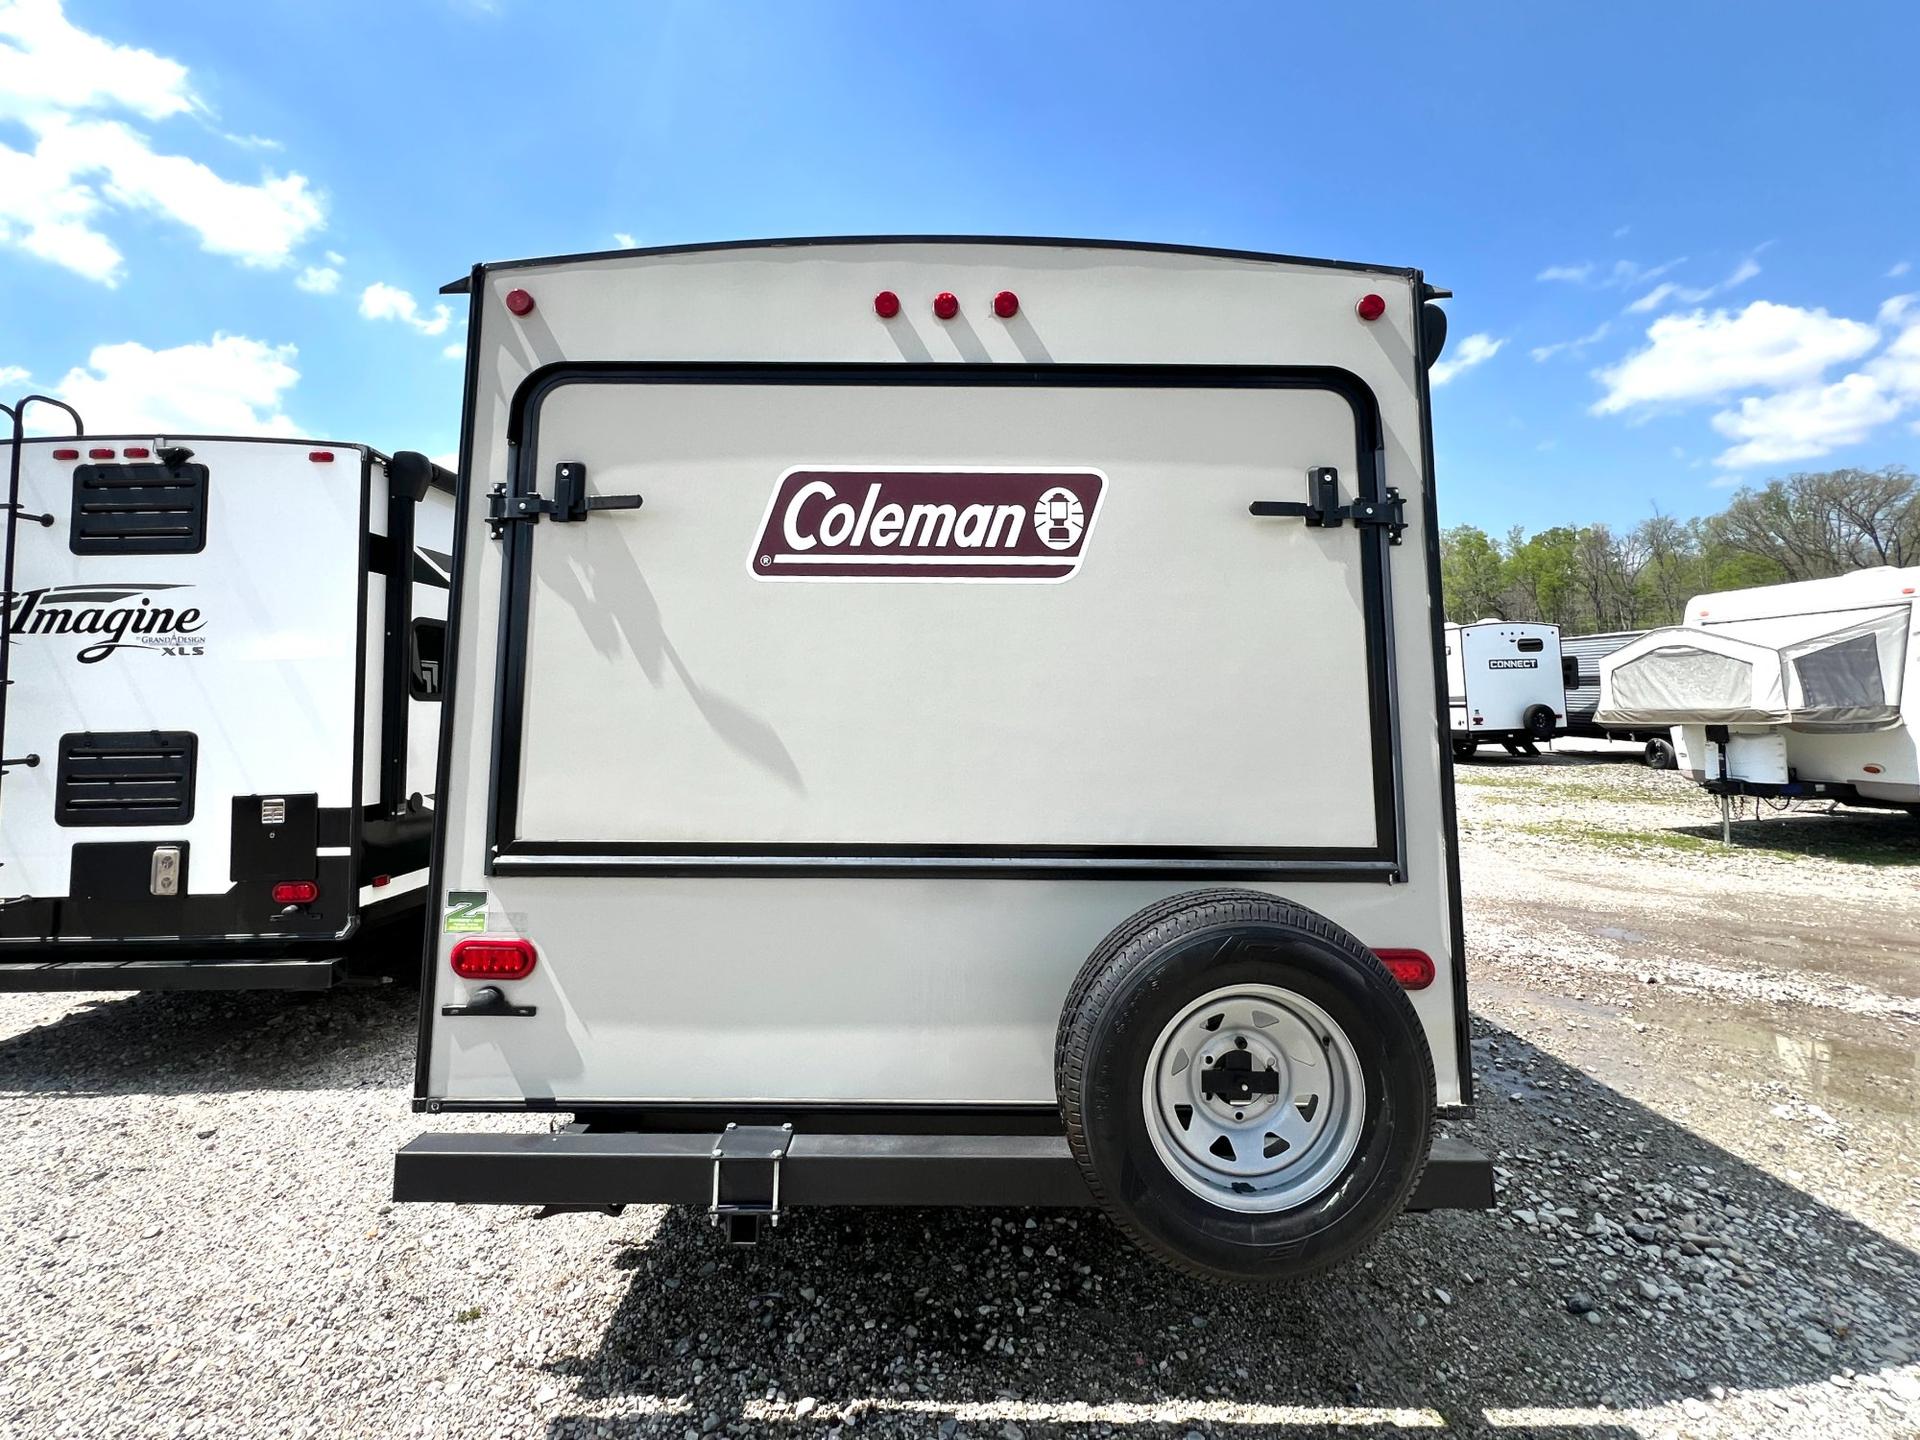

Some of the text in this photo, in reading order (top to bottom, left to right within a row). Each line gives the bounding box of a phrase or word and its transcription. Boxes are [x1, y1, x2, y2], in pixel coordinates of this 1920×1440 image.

[783, 480, 1026, 551] Coleman
[9, 587, 209, 664] Imagine
[161, 646, 204, 657] XLS
[1490, 660, 1536, 669] CONNECT
